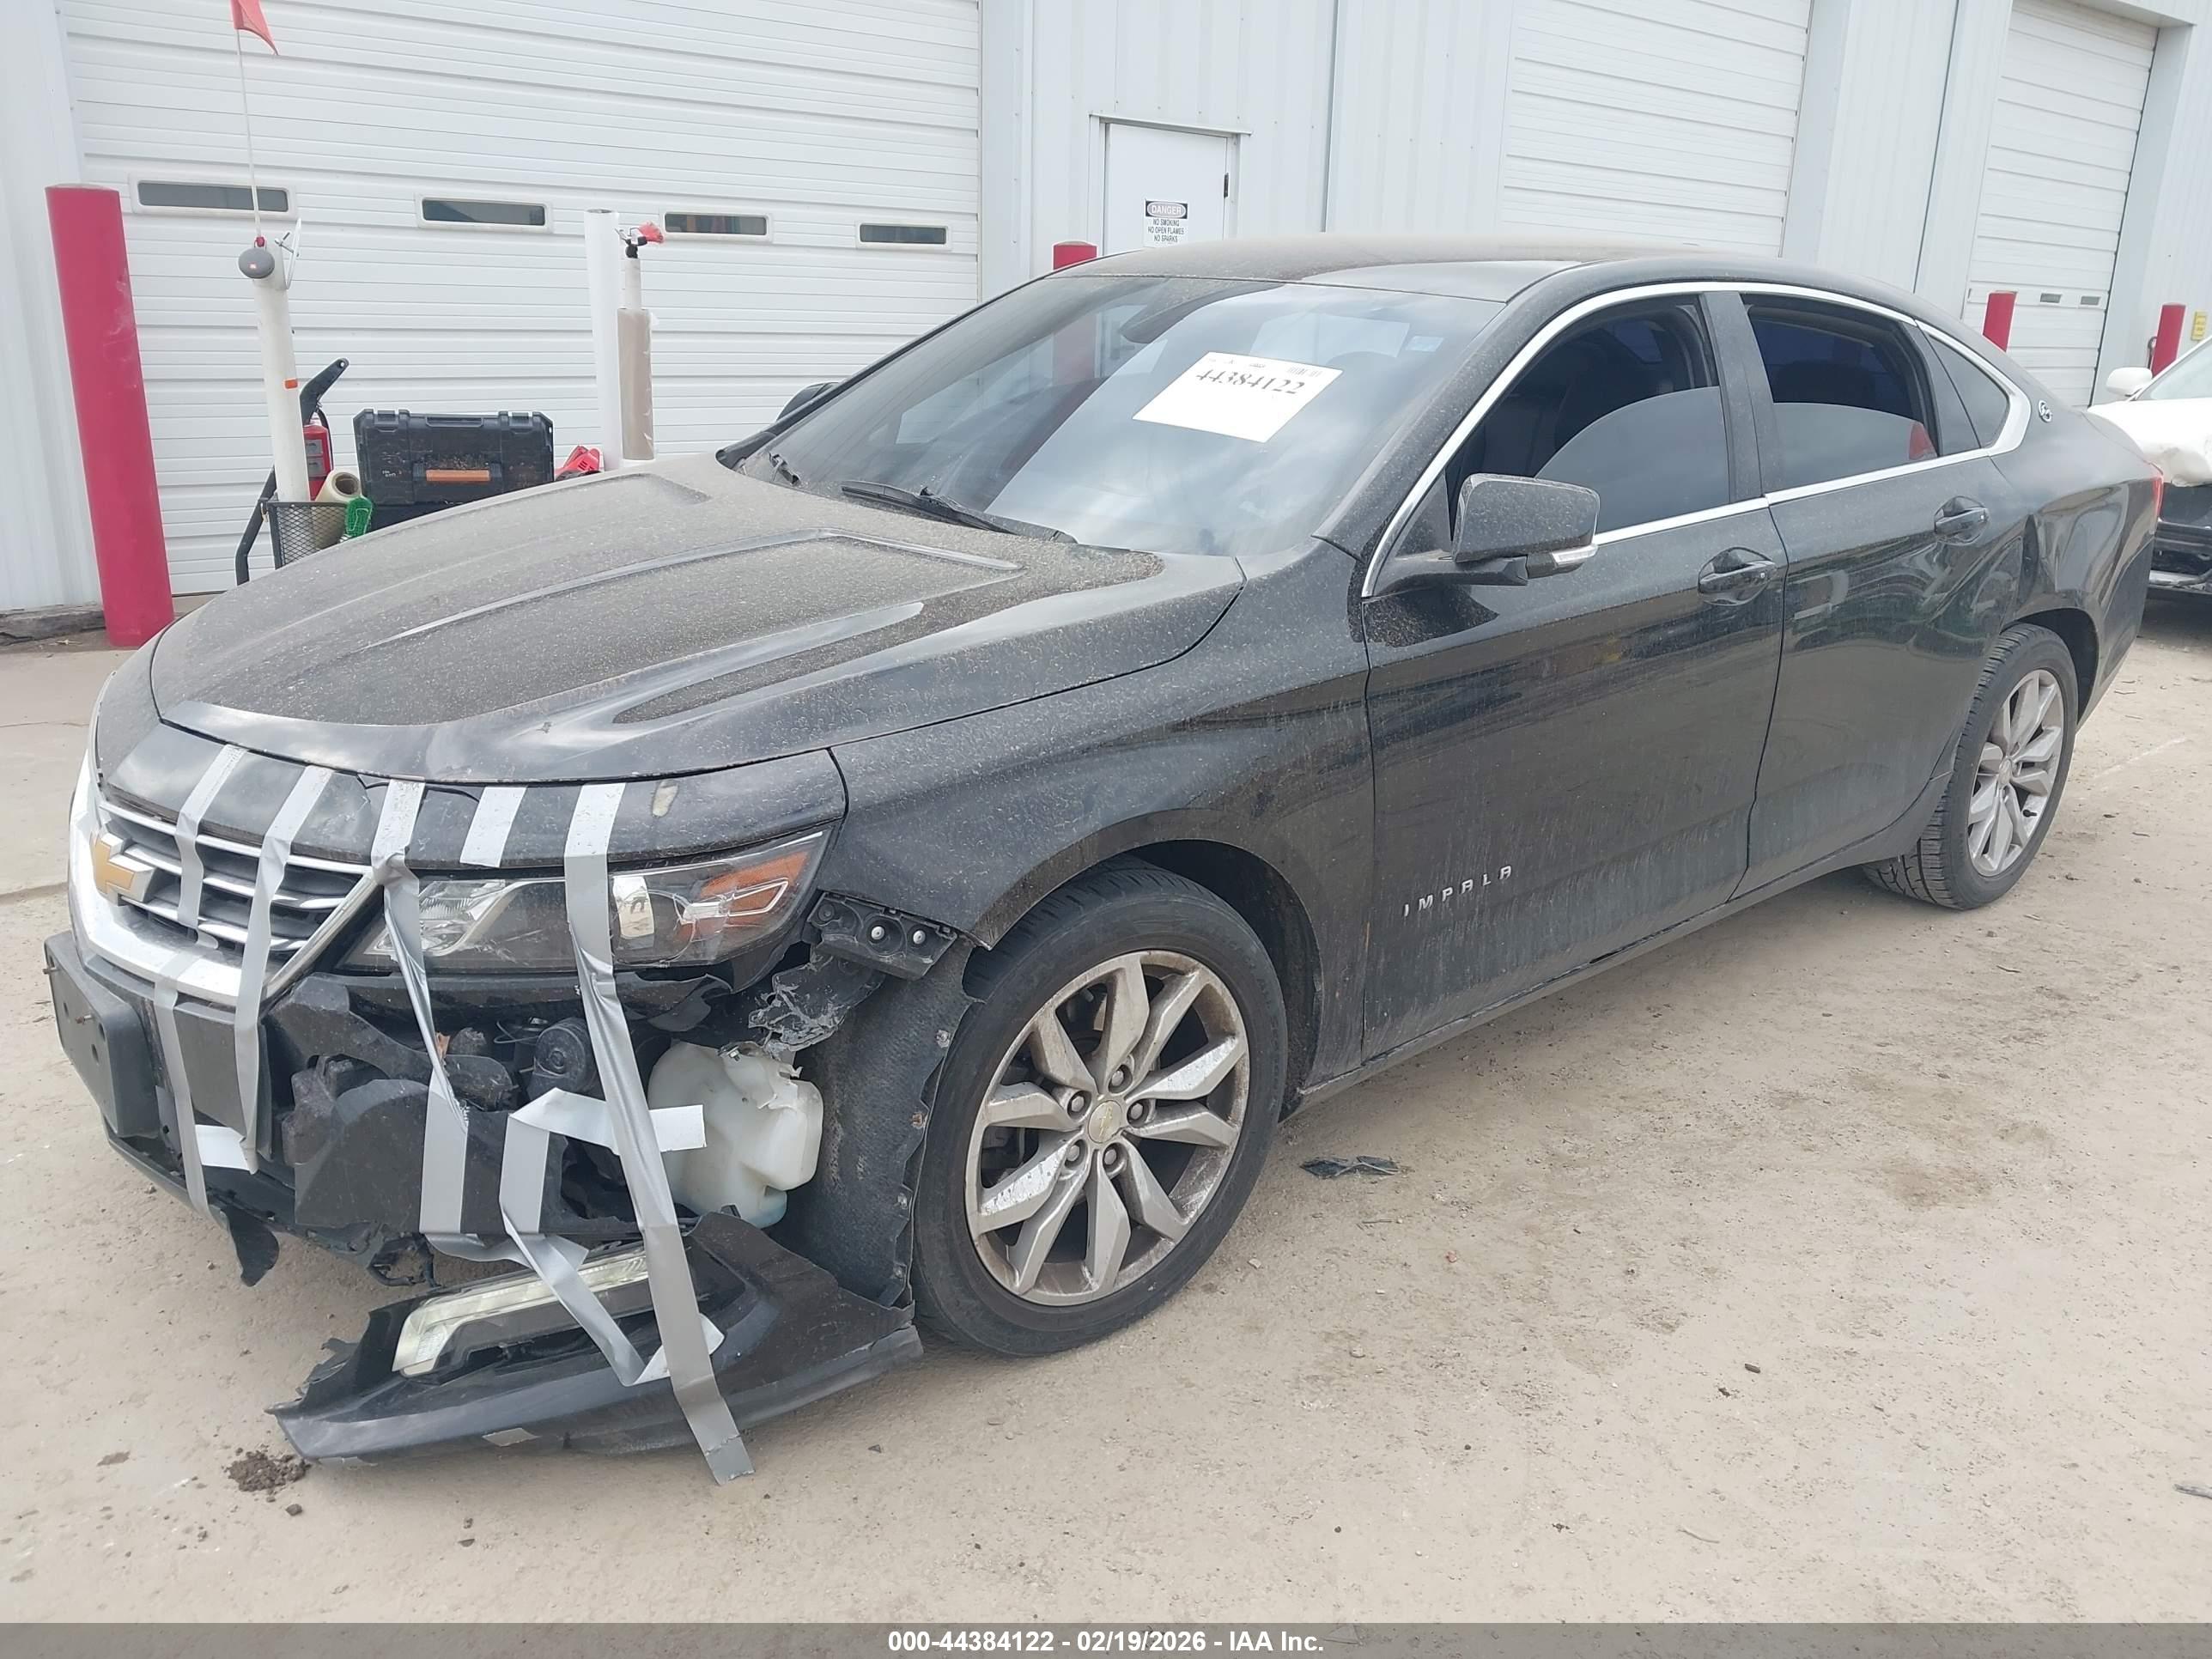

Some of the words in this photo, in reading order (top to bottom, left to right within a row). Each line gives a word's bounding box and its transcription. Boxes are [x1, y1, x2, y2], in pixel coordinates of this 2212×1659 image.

[1152, 205, 1182, 215] DANGER
[1195, 369, 1305, 394] 44384122
[1402, 865, 1513, 917] IMPALA
